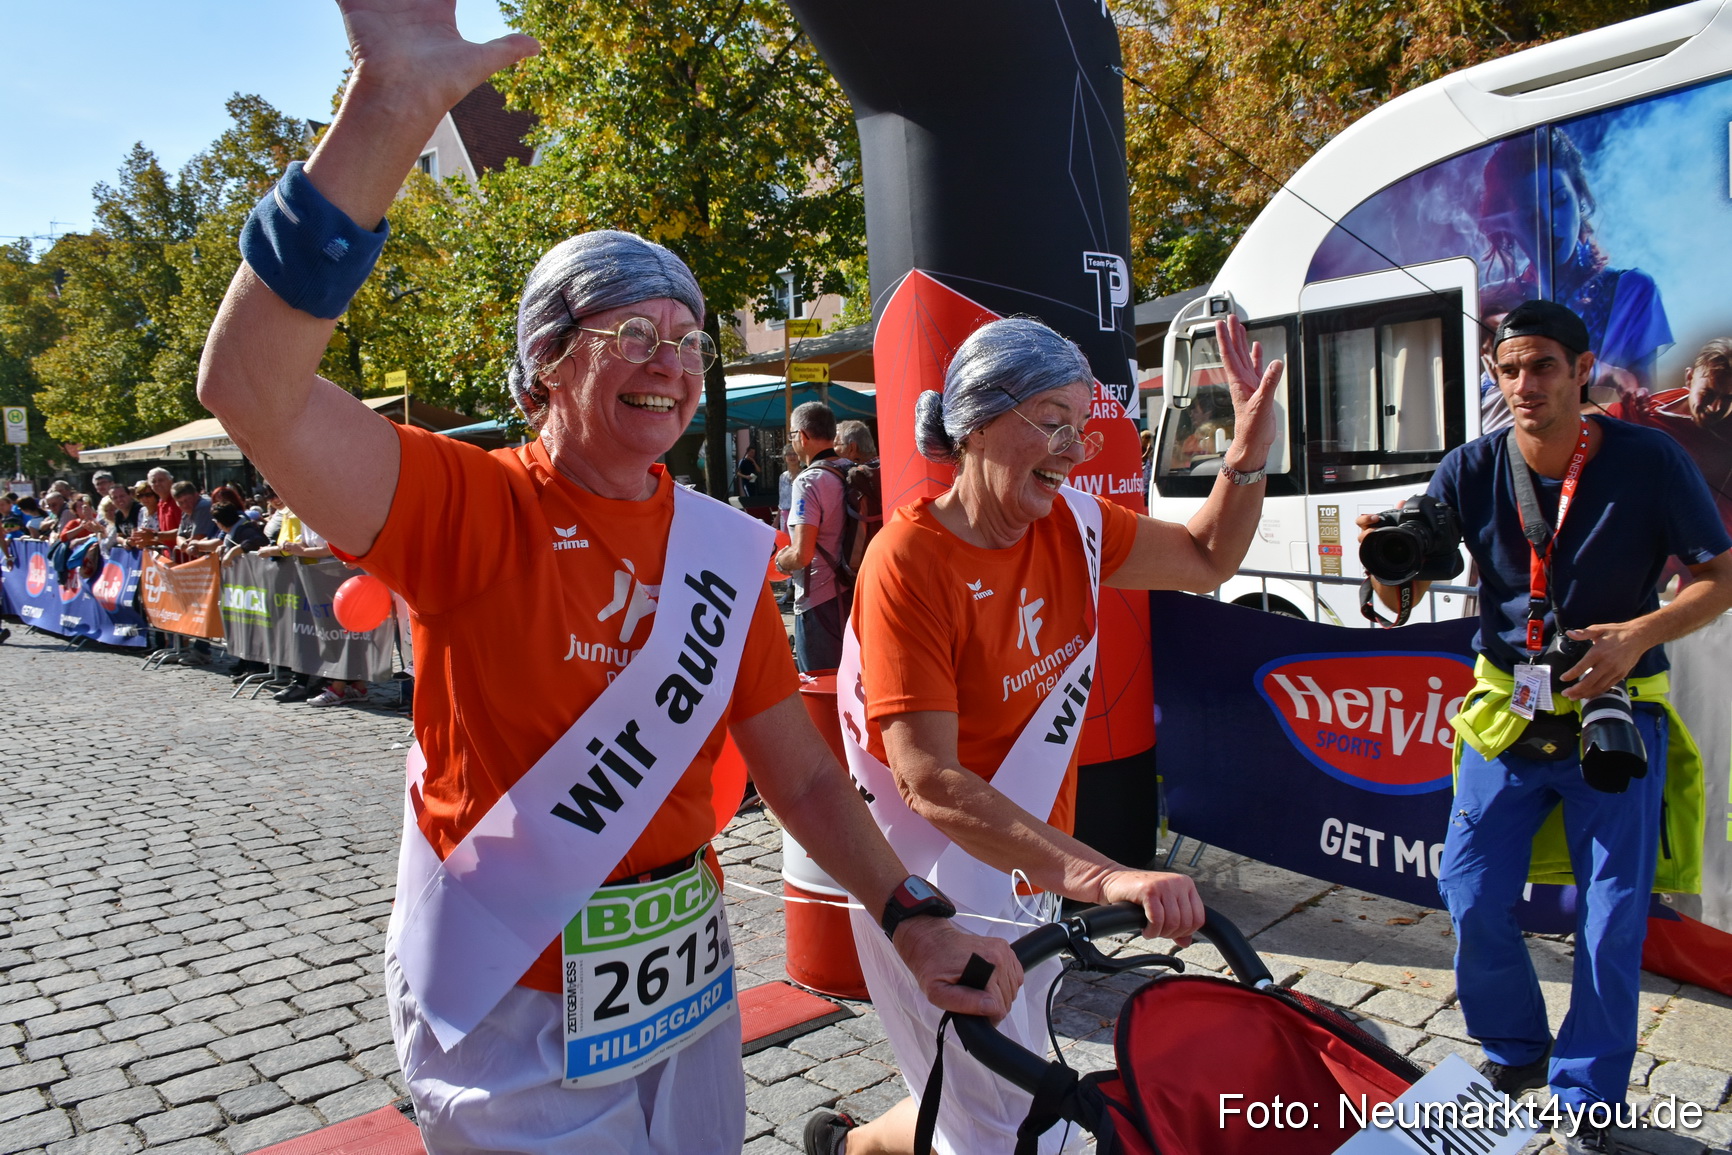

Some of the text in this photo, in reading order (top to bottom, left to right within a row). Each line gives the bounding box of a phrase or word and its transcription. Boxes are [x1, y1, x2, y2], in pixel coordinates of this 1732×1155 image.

[1087, 258, 1105, 267] Team
[1101, 384, 1128, 400] NEXT
[1065, 474, 1104, 496] MW
[1565, 453, 1584, 490] ENERGY
[1320, 508, 1337, 516] TOP
[1320, 526, 1339, 536] 2018
[1401, 587, 1410, 608] EOS
[655, 570, 738, 724] auch
[1003, 634, 1085, 702] funrunners
[1044, 664, 1092, 745] wir
[1271, 674, 1466, 756] Hervis
[1316, 730, 1382, 760] SPORTS
[550, 719, 657, 834] wir
[1320, 817, 1385, 867] GET
[594, 916, 719, 1022] 2613
[589, 982, 723, 1066] HILDEGARD
